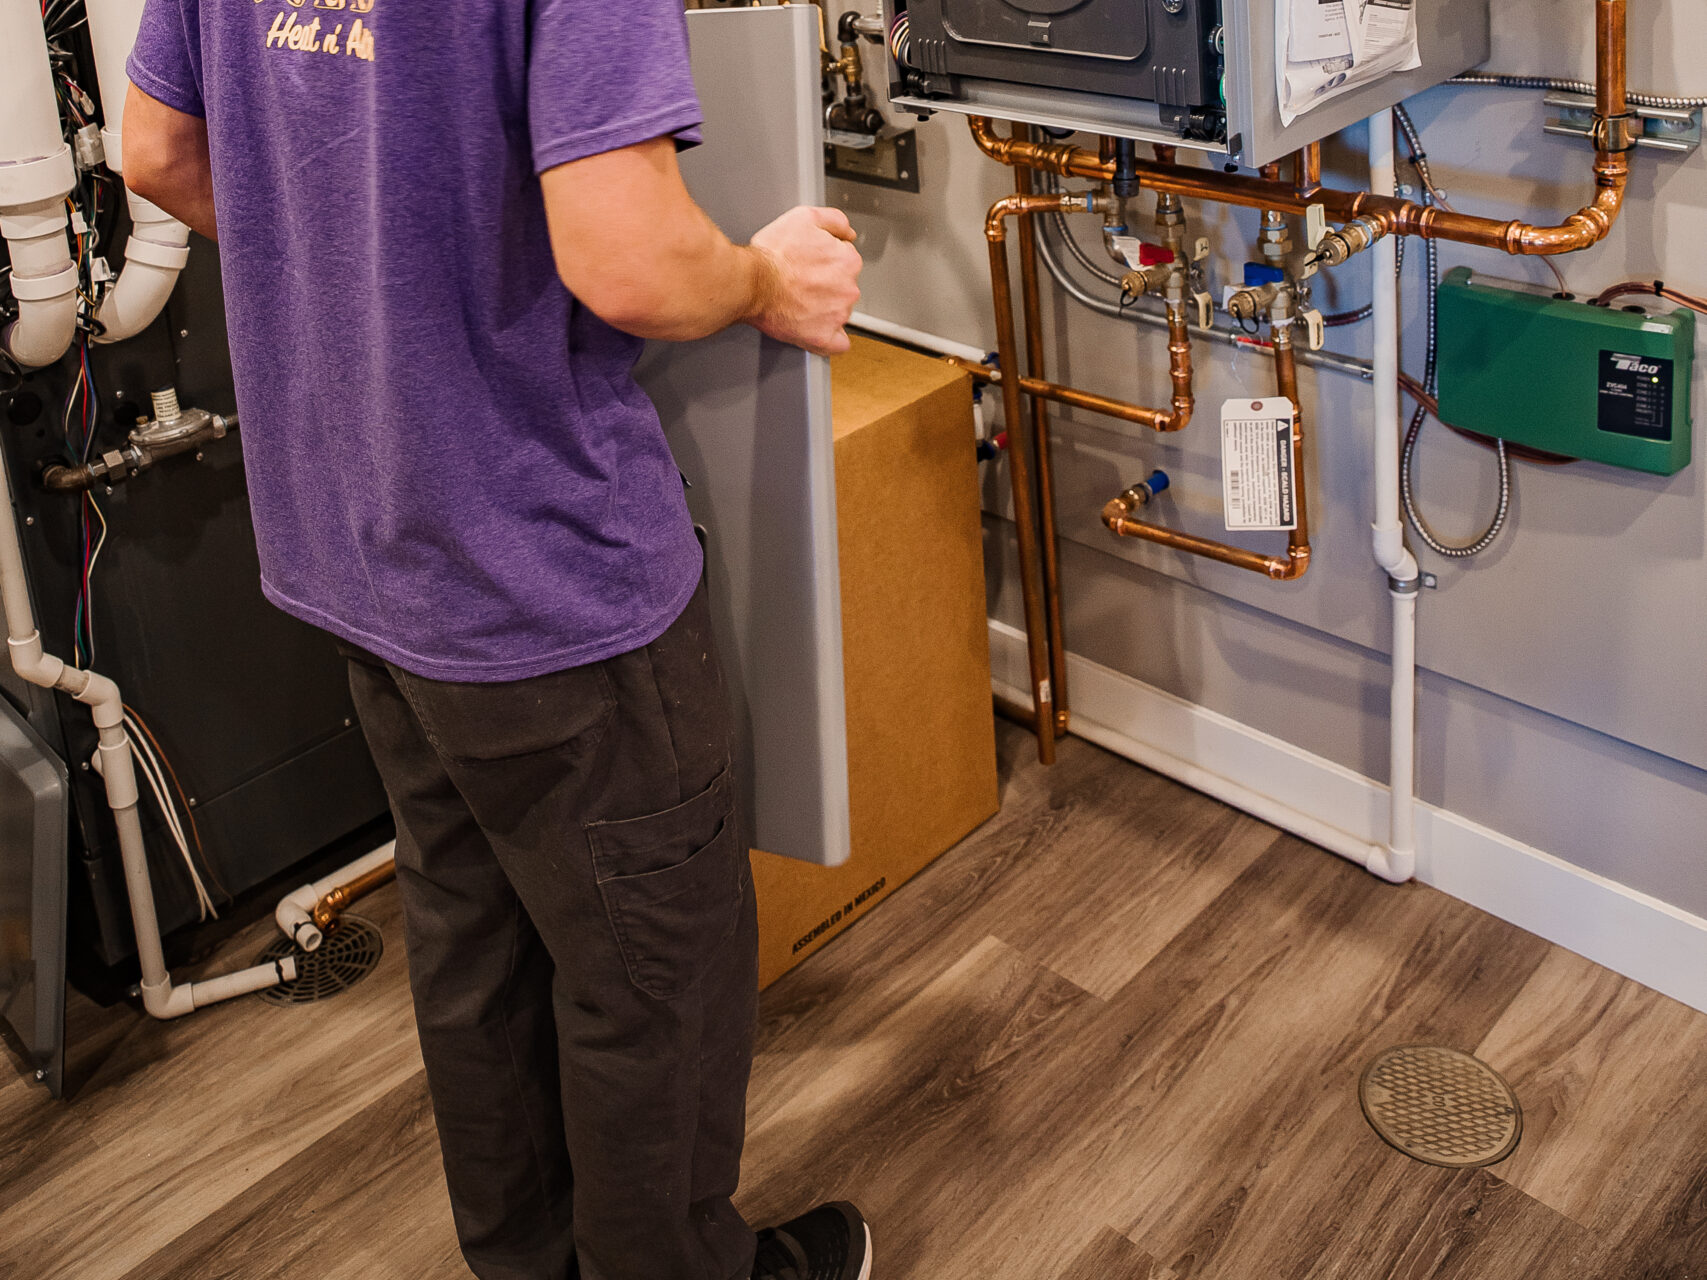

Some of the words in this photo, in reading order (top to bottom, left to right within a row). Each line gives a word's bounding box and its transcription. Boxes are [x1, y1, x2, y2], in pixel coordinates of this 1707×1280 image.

[266, 11, 321, 53] Heat
[1610, 353, 1659, 374] Taco
[792, 910, 842, 955] ASSEMBLED
[843, 901, 854, 917] IN
[855, 876, 886, 907] MEXICO
